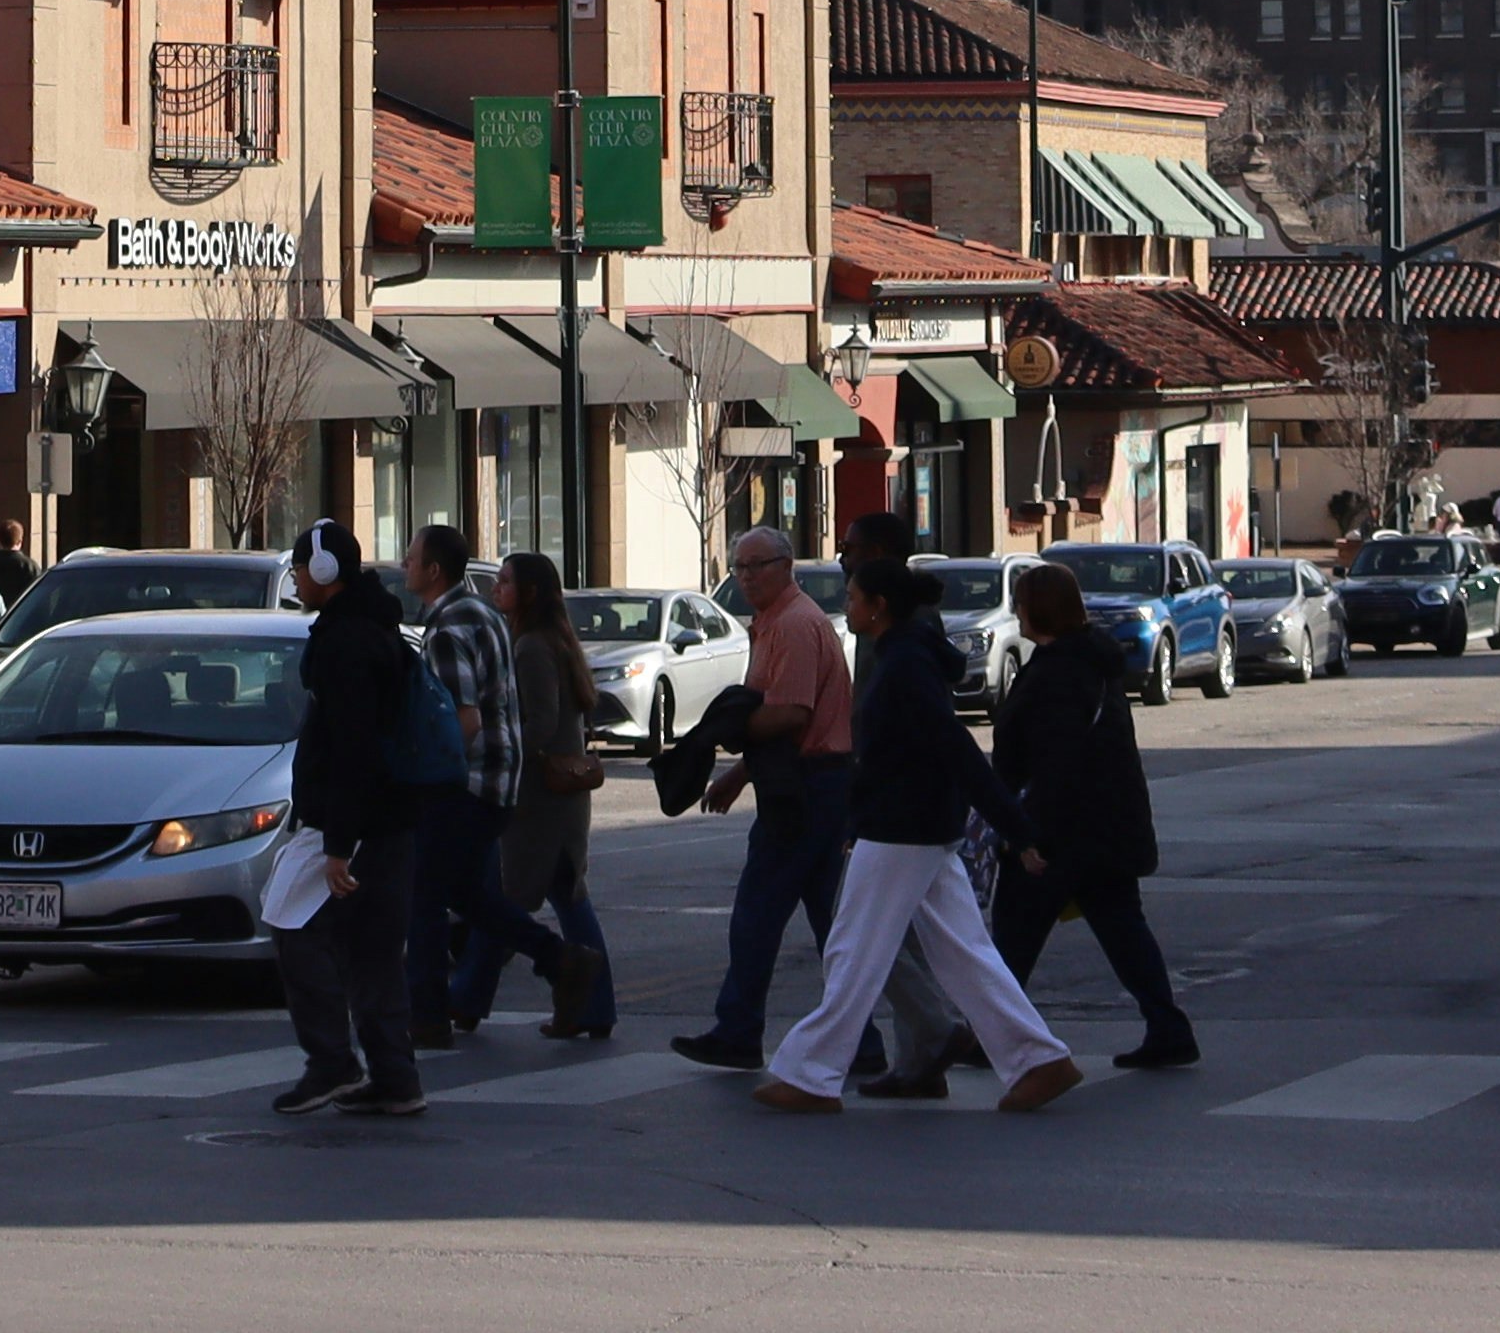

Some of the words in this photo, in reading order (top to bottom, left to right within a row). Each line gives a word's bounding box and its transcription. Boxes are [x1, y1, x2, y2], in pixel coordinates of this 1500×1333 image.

[481, 110, 542, 122] COUNTRY
[589, 109, 654, 121] COUNTRY
[481, 123, 515, 135] CLUB
[589, 122, 625, 134] CLUB
[481, 136, 522, 148] PLAZA
[589, 135, 632, 147] PLAZA
